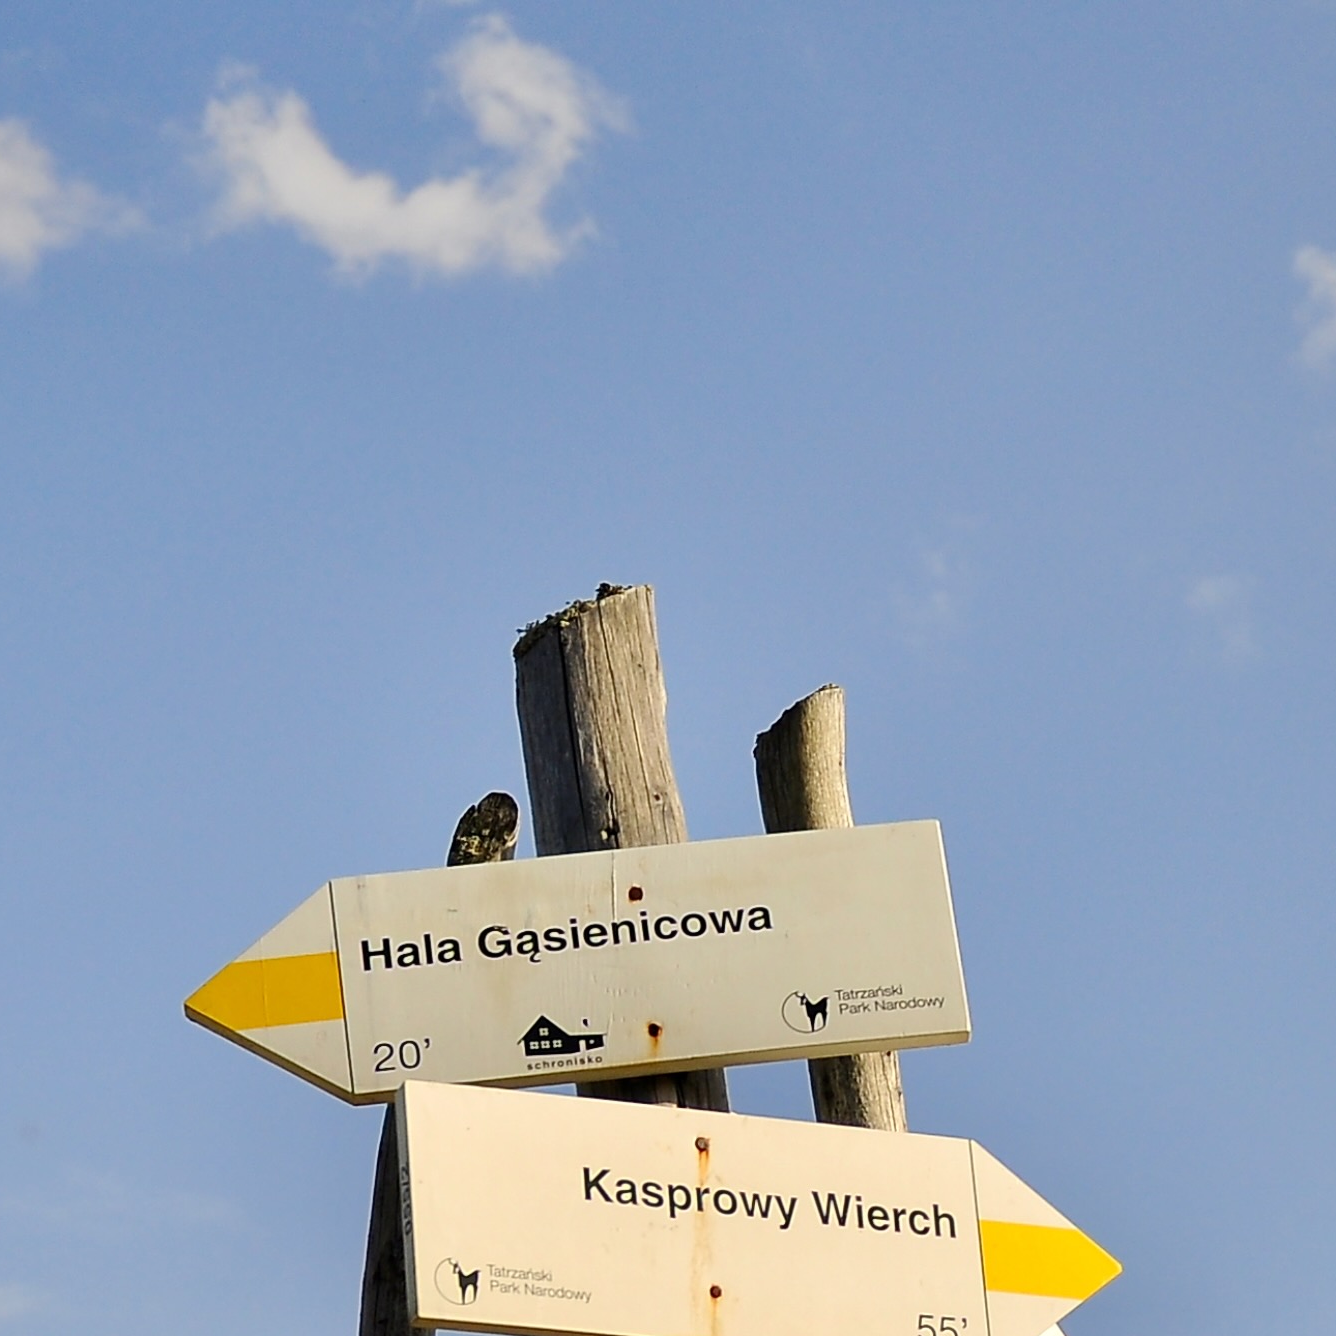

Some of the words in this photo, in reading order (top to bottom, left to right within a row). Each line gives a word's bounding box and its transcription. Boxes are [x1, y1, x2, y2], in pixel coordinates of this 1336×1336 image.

[360, 933, 463, 972] Hala
[477, 904, 773, 963] Gąsienicowa
[834, 984, 903, 1001] Tatrzański
[839, 1001, 871, 1015] Park
[875, 997, 945, 1012] Narodowy
[526, 1055, 603, 1071] schronisko
[583, 1167, 797, 1230] Kasprowy
[812, 1191, 957, 1238] Wierch
[486, 1263, 553, 1282] Tatrzański
[490, 1280, 520, 1295] Park
[524, 1283, 592, 1304] Narodowy
